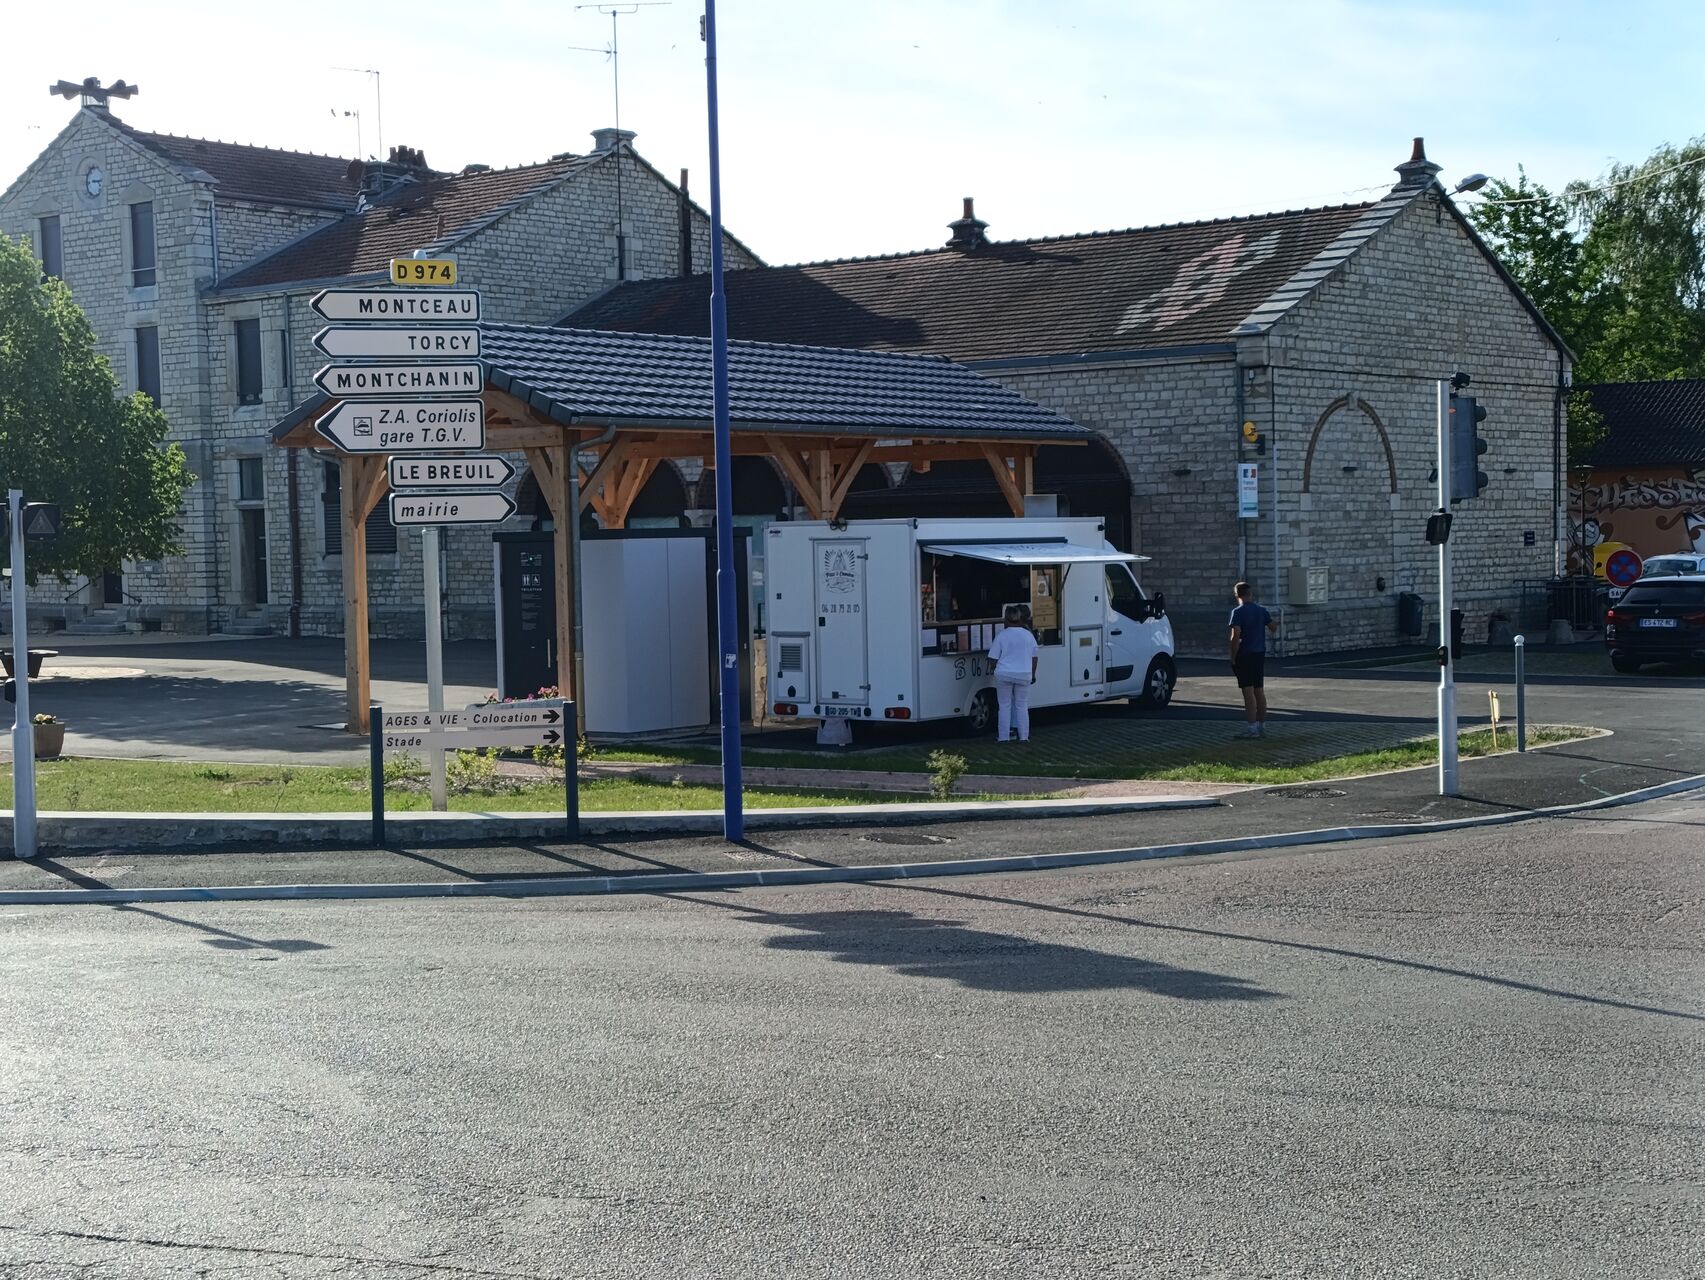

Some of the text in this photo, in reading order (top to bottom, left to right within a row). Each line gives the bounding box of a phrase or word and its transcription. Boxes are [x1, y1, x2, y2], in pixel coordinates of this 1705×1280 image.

[397, 265, 451, 279] D 974
[359, 298, 471, 314] MONTCEAU
[408, 335, 471, 350] TORCY
[337, 371, 474, 388] MONTCHANIN
[379, 408, 476, 424] Z.A. Coriolis
[380, 427, 466, 446] gare T.G.V.
[399, 465, 495, 480] LE BREUIL
[401, 501, 459, 517] mairie
[971, 657, 982, 677] 06
[385, 716, 418, 727] AGES
[423, 715, 432, 725] &
[439, 714, 458, 725] VIE
[473, 712, 538, 724] Colocation
[386, 736, 422, 748] Stade
